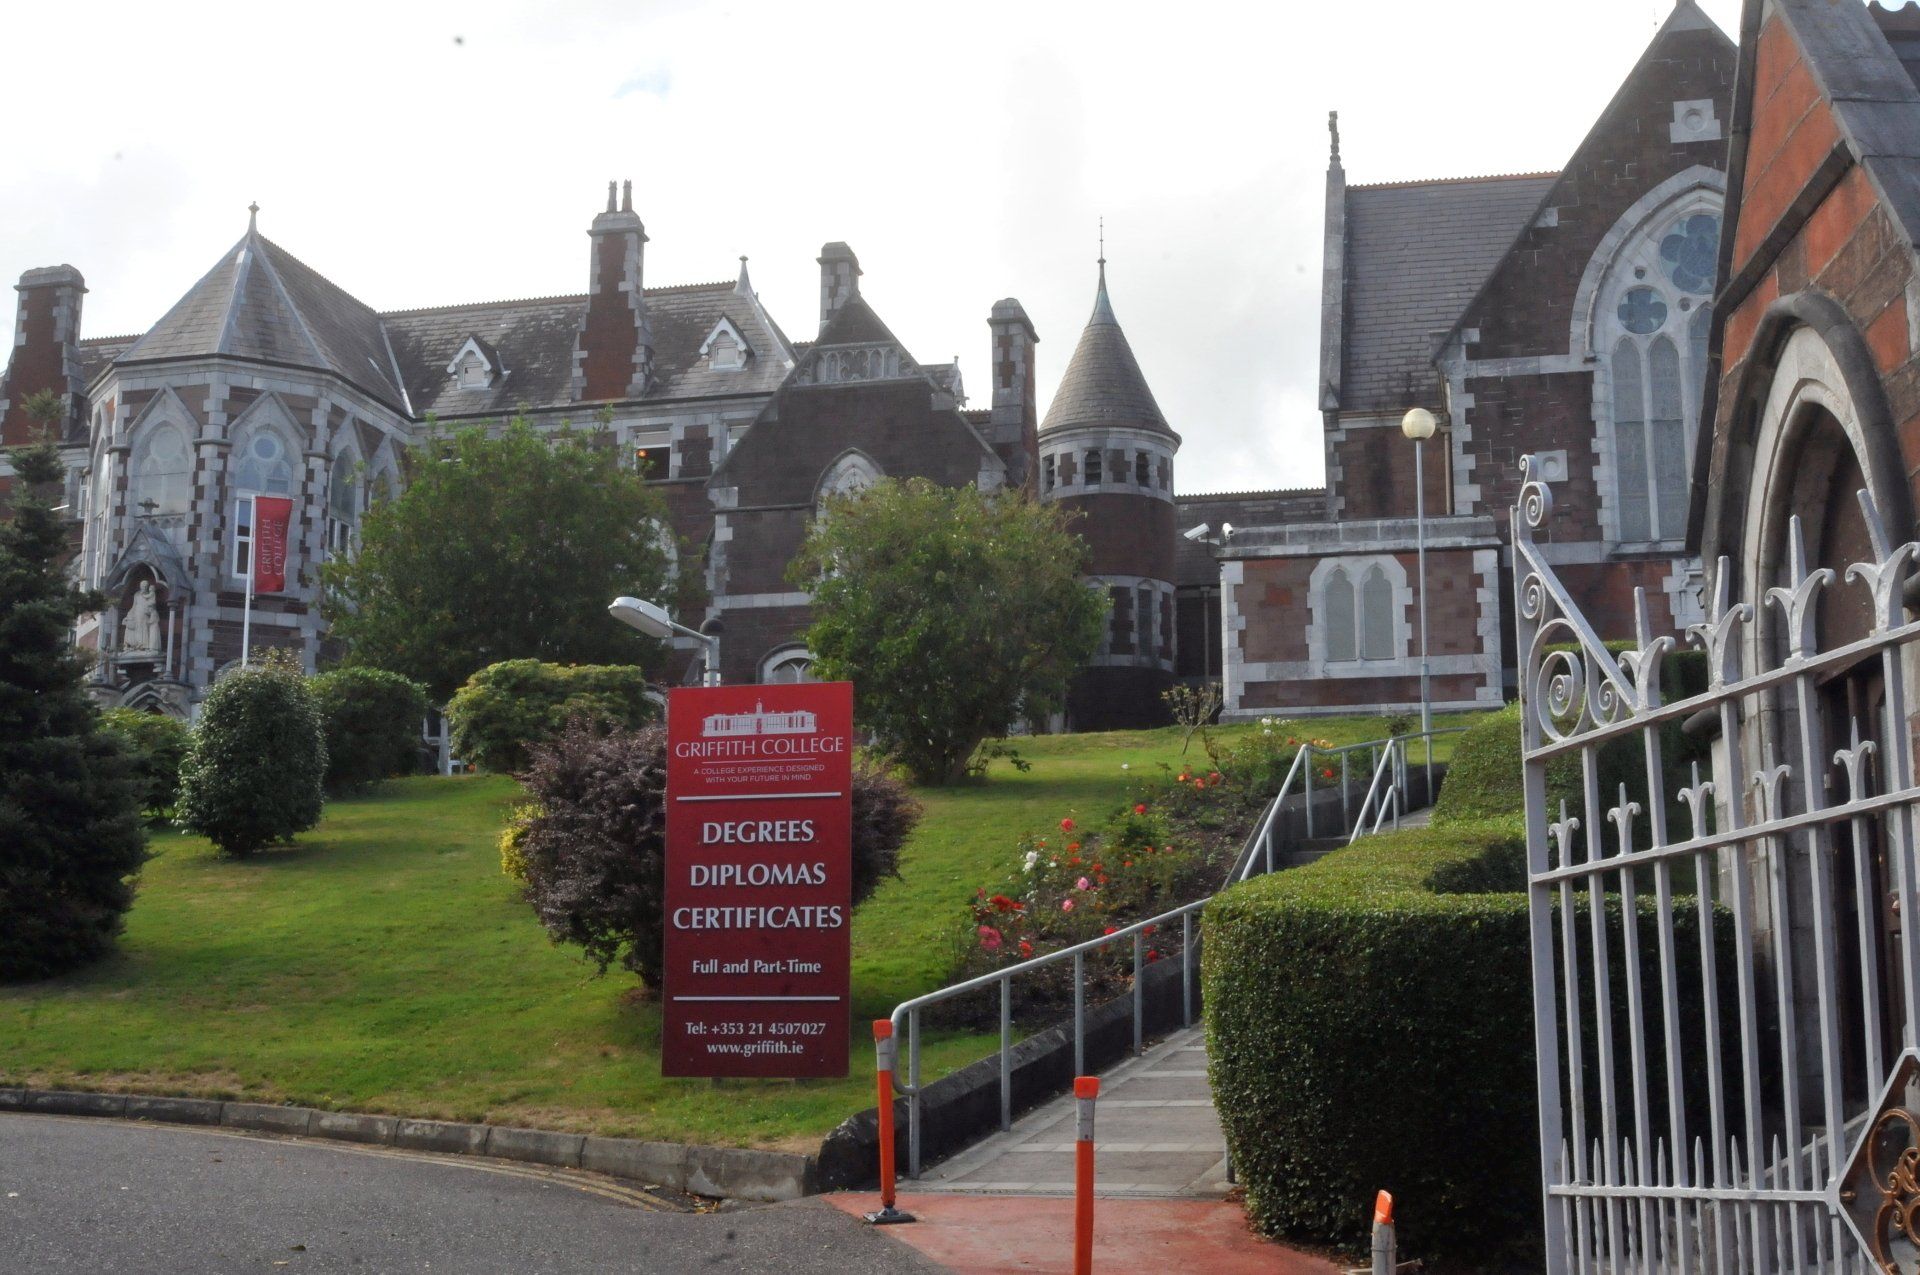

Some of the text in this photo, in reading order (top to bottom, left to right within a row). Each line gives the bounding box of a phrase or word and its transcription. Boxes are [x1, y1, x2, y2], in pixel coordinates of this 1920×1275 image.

[262, 519, 271, 575] GRIFFITH
[675, 737, 844, 758] GRIFFITH COLLEGE
[701, 767, 735, 775] COLLEGE
[737, 766, 784, 774] EXPERIENCE
[786, 764, 825, 772] DESIGNED
[703, 820, 814, 843] DEGREES
[690, 863, 826, 886] DIPLOMAS
[673, 906, 842, 929] CERTIFICATES
[692, 959, 822, 973] Full and Part-Time
[685, 1021, 826, 1035] Tel: +353 21 4507027
[707, 1040, 804, 1057] www.griffith.ie
